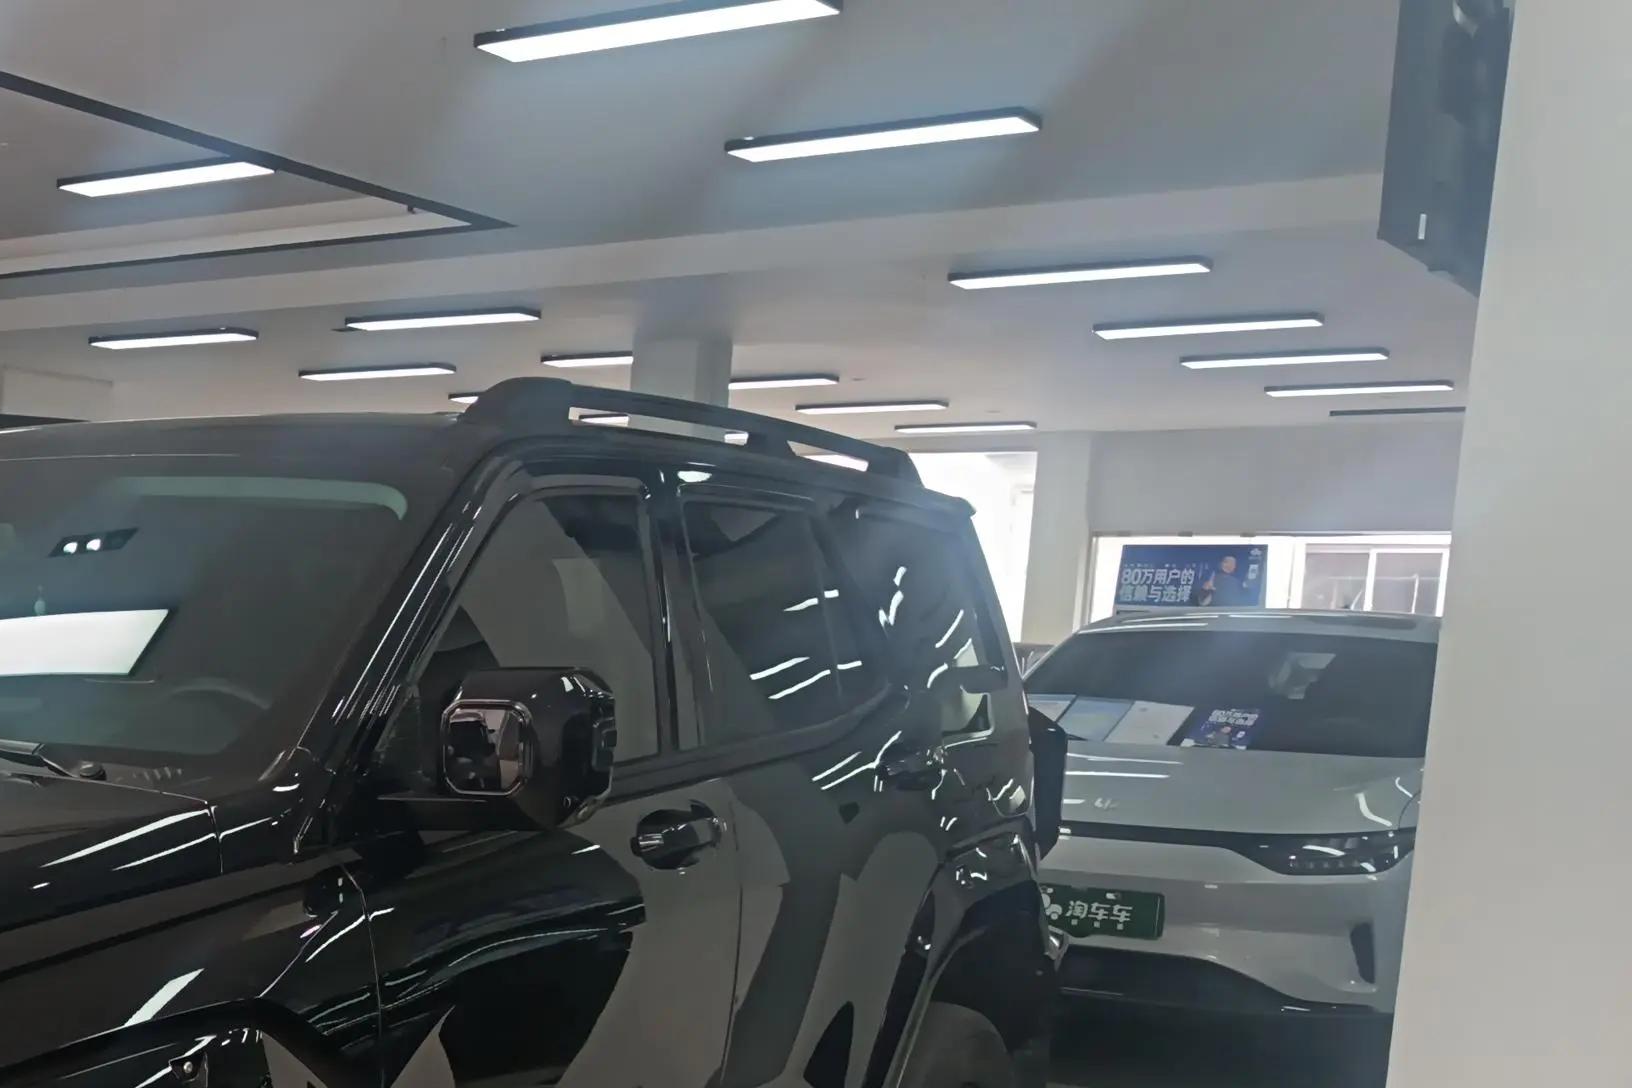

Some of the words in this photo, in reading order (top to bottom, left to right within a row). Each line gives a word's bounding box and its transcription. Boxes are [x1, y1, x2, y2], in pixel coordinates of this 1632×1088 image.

[1121, 568, 1195, 585] 80万用户的
[1065, 900, 1133, 922] 淘车车
